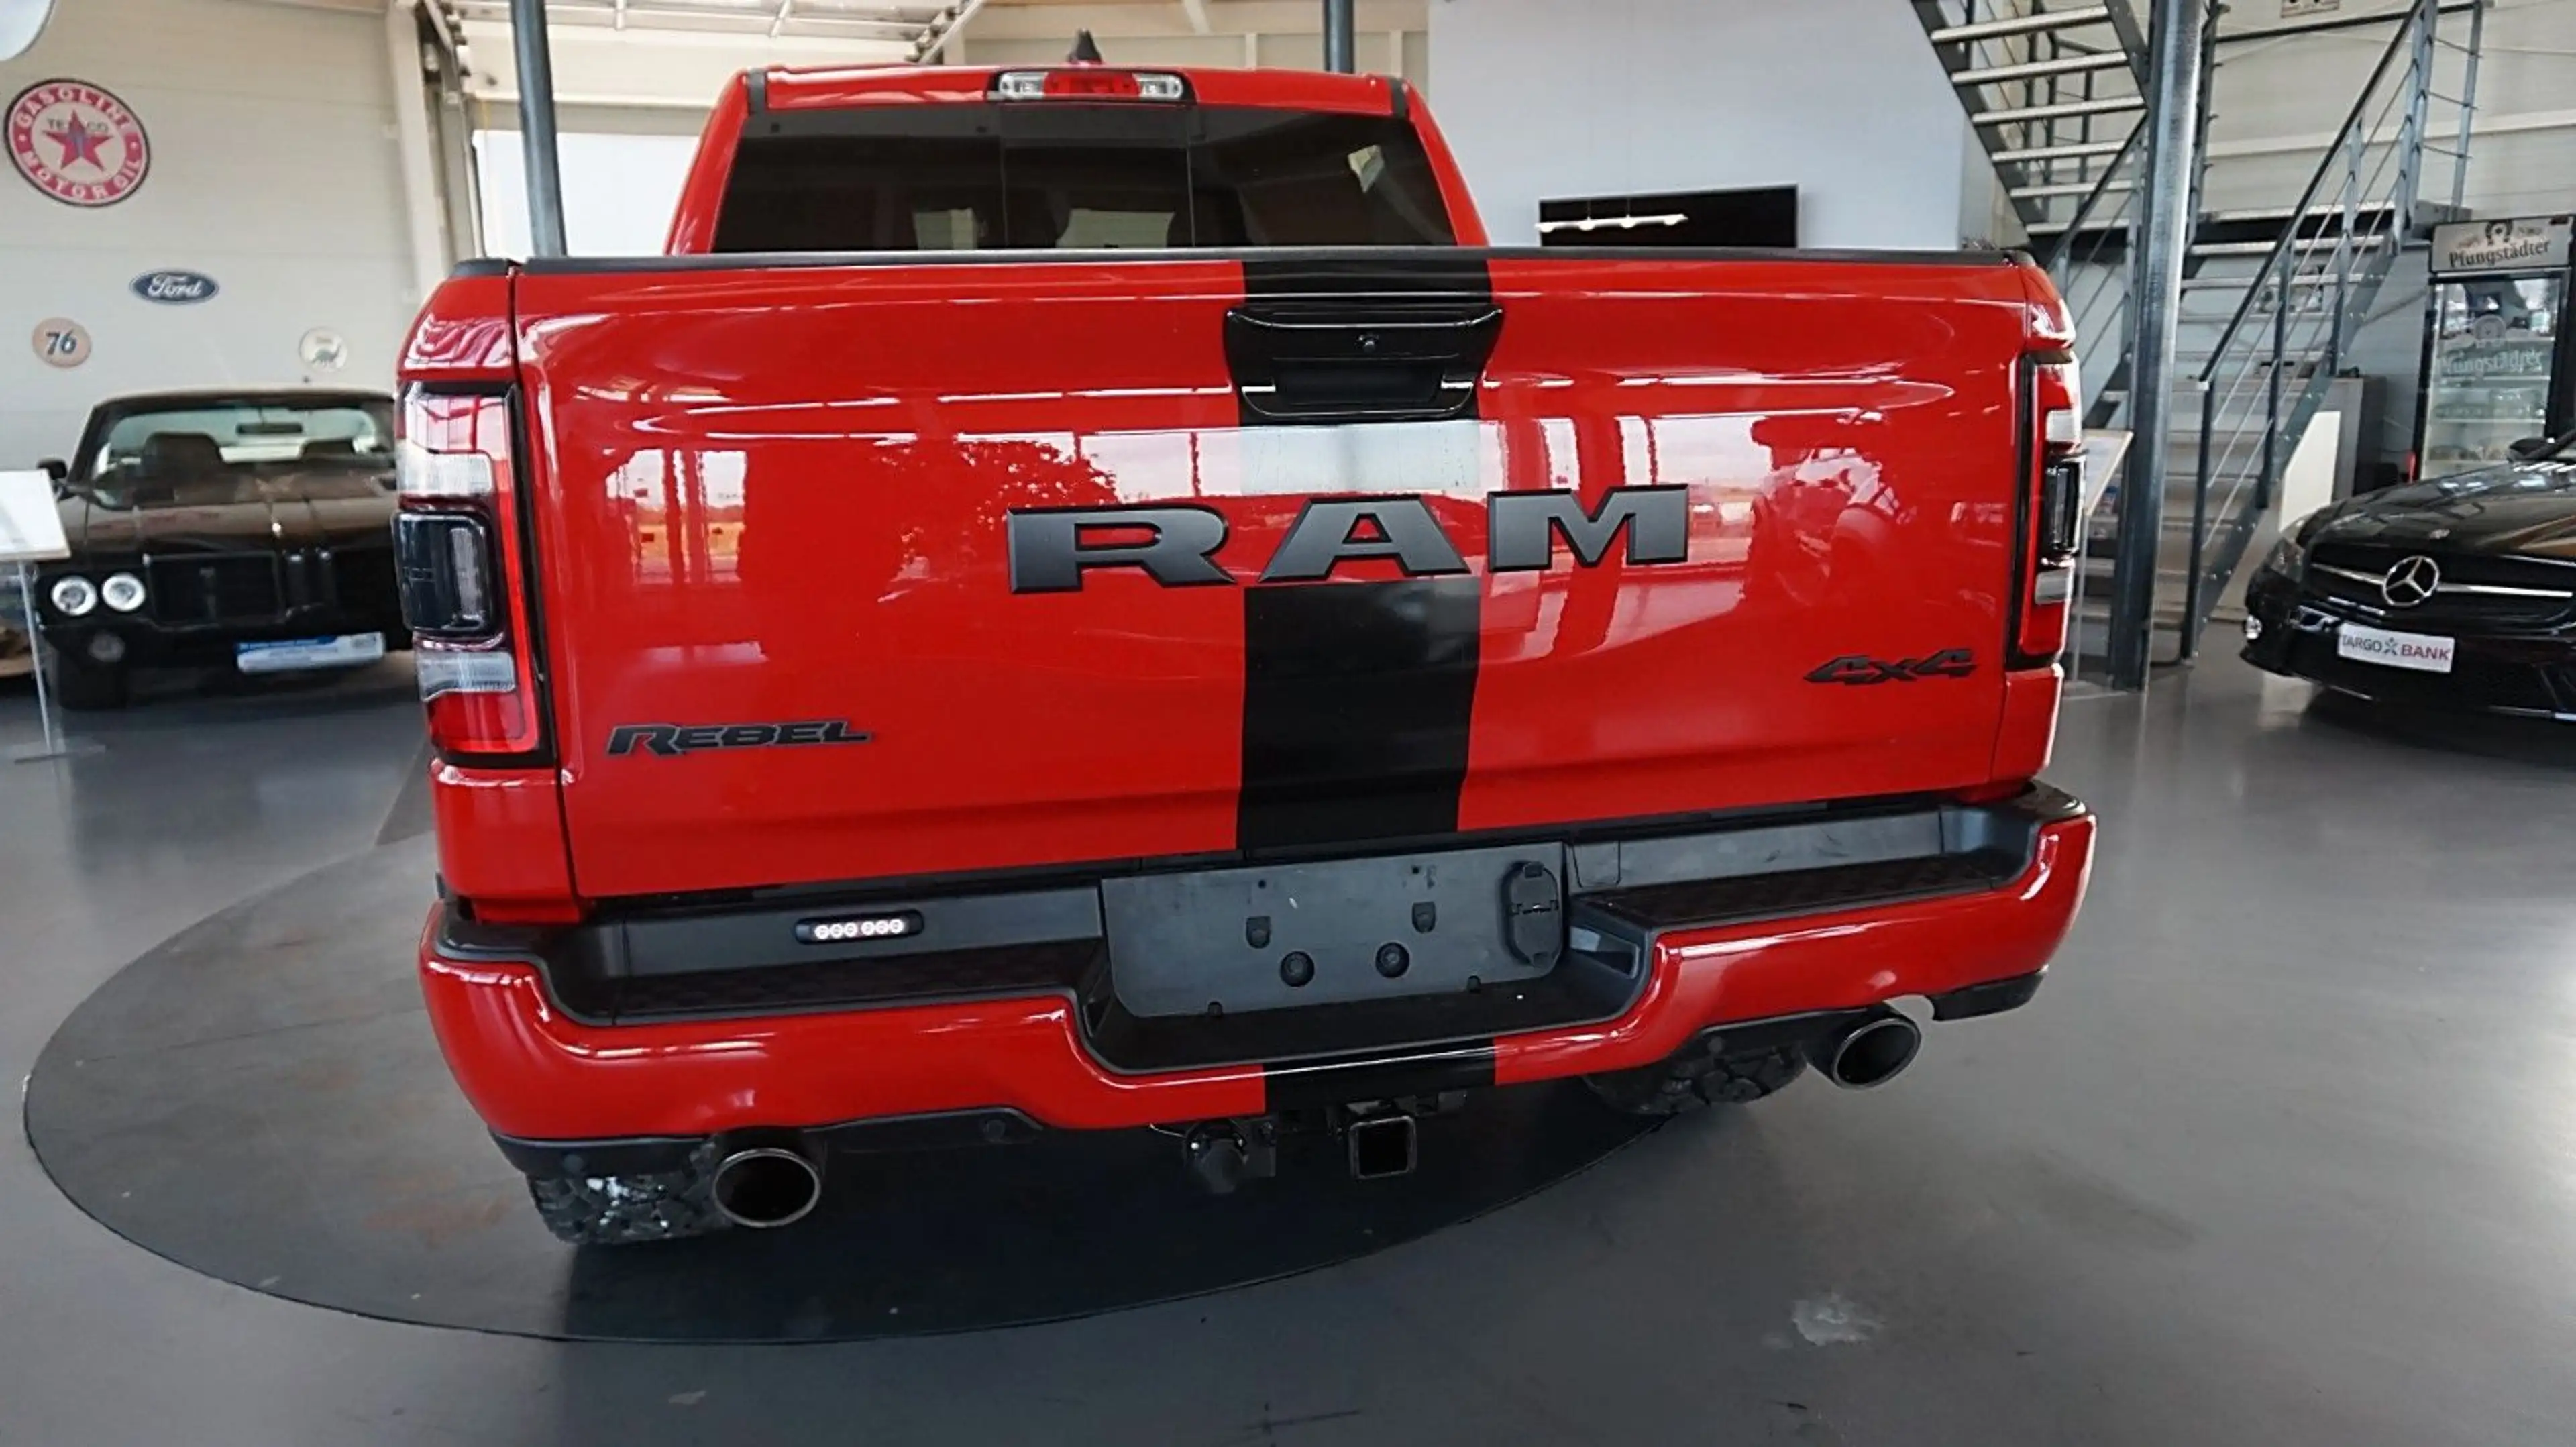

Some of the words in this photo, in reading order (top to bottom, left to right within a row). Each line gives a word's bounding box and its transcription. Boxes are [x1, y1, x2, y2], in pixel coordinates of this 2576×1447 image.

[15, 88, 138, 132] GASOLINE
[22, 151, 107, 199] MOTOR
[2449, 237, 2551, 268] Pfungstädter
[148, 273, 202, 298] Ford
[44, 327, 77, 356] 76
[1006, 484, 1690, 595] RAM
[2342, 634, 2383, 653] TARGO
[2400, 643, 2450, 661] BANK
[1803, 648, 1978, 685] 4x4
[607, 720, 872, 757] REBEL
